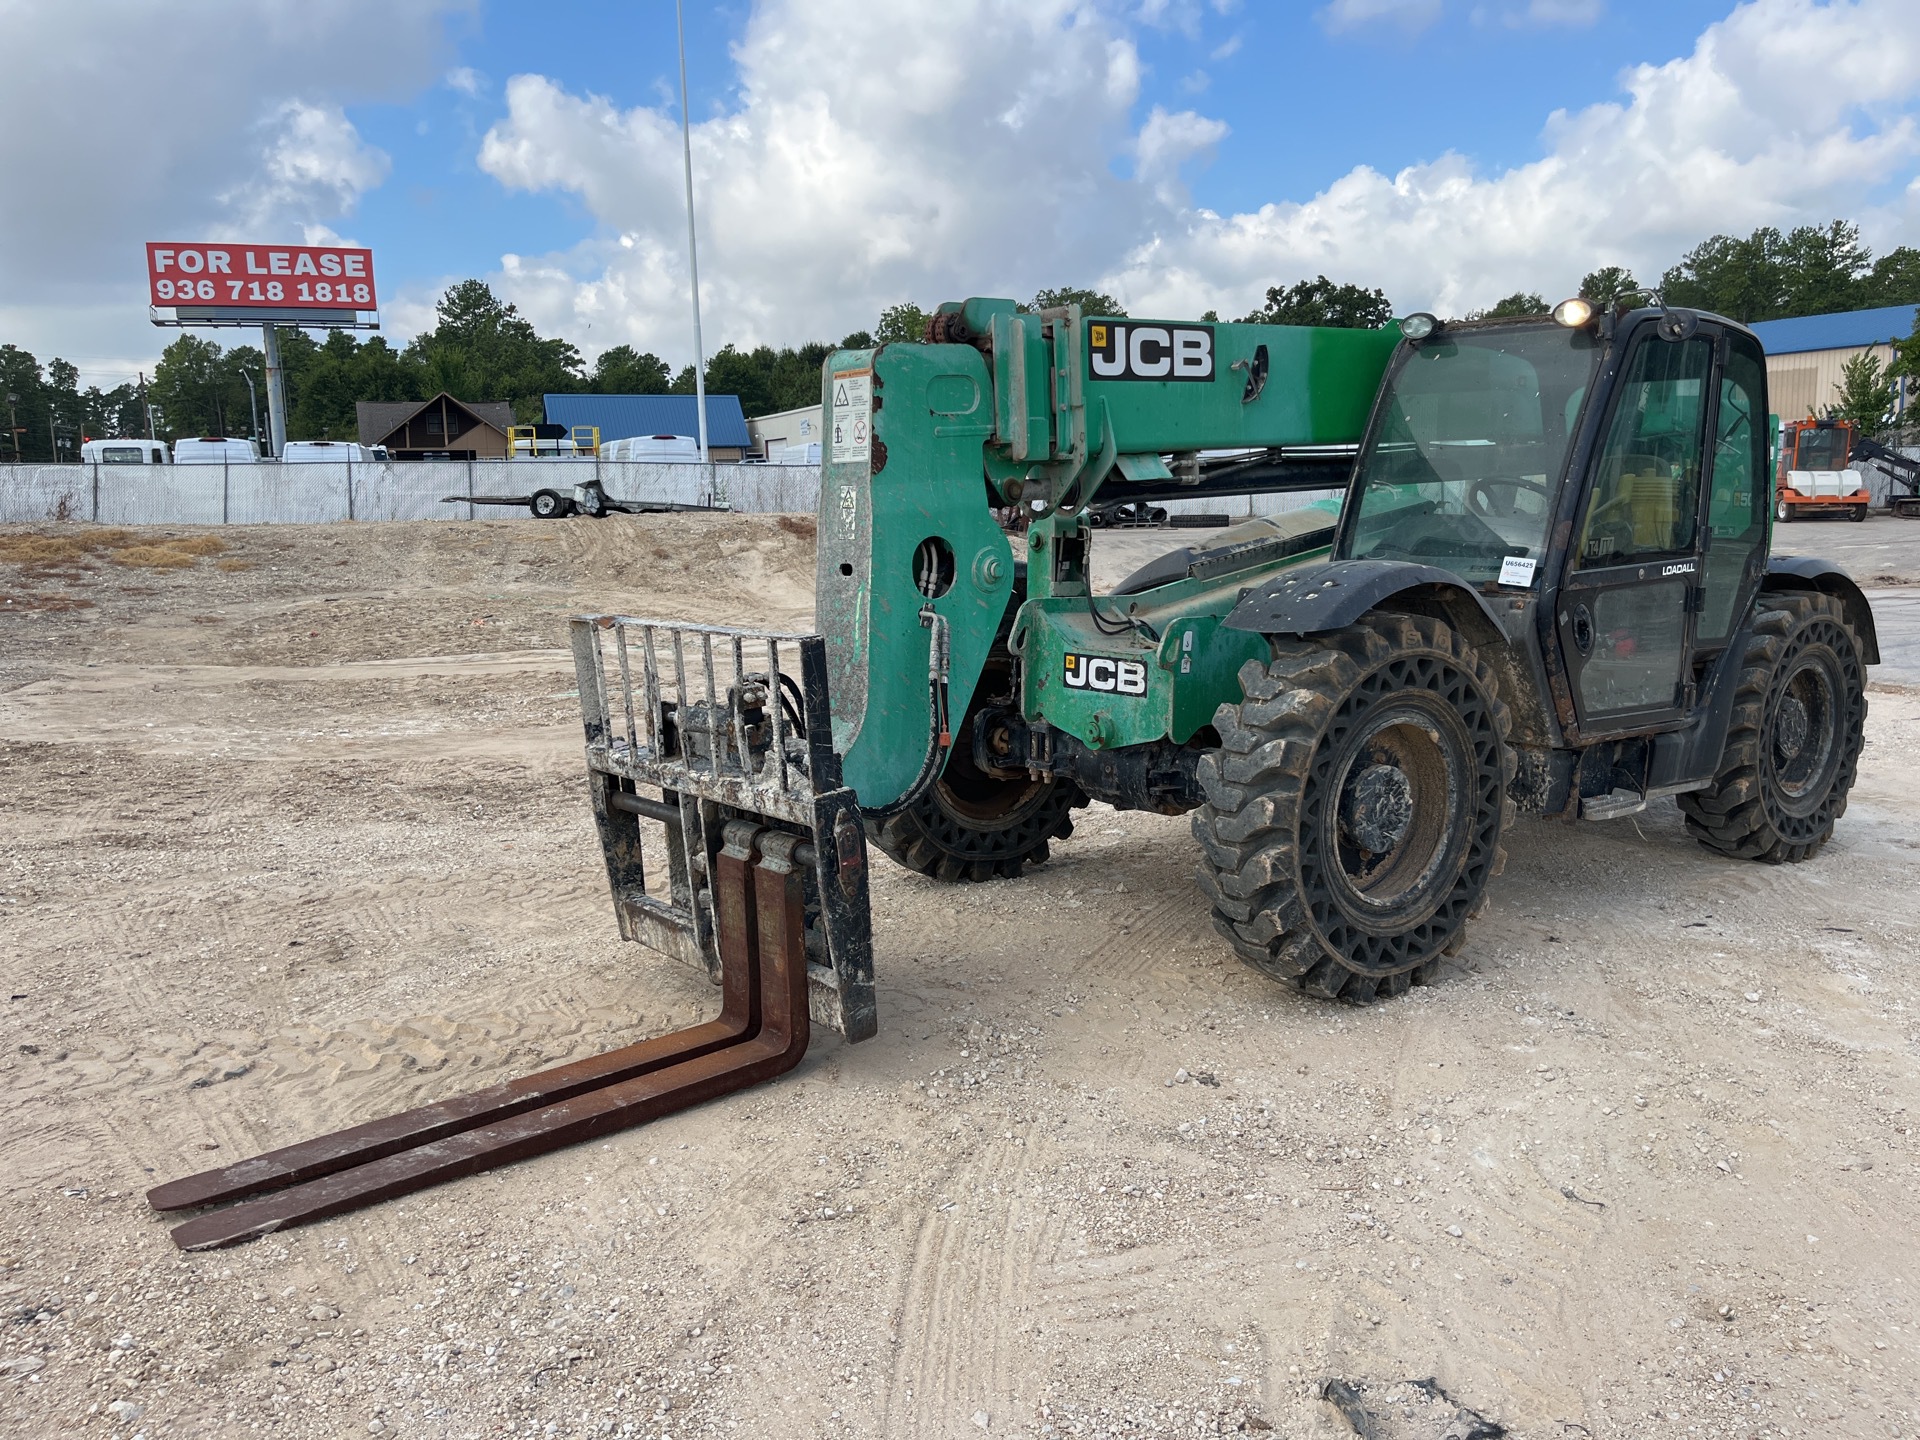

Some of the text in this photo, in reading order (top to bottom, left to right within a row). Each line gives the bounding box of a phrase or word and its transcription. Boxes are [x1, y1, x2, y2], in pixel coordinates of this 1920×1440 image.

[154, 250, 366, 278] FOR LEASE
[156, 279, 371, 303] 936 718 1818
[1091, 326, 1212, 377] JCB
[1505, 561, 1534, 569] U656425
[1662, 563, 1695, 576] LOADALL
[1065, 656, 1146, 694] JCB
